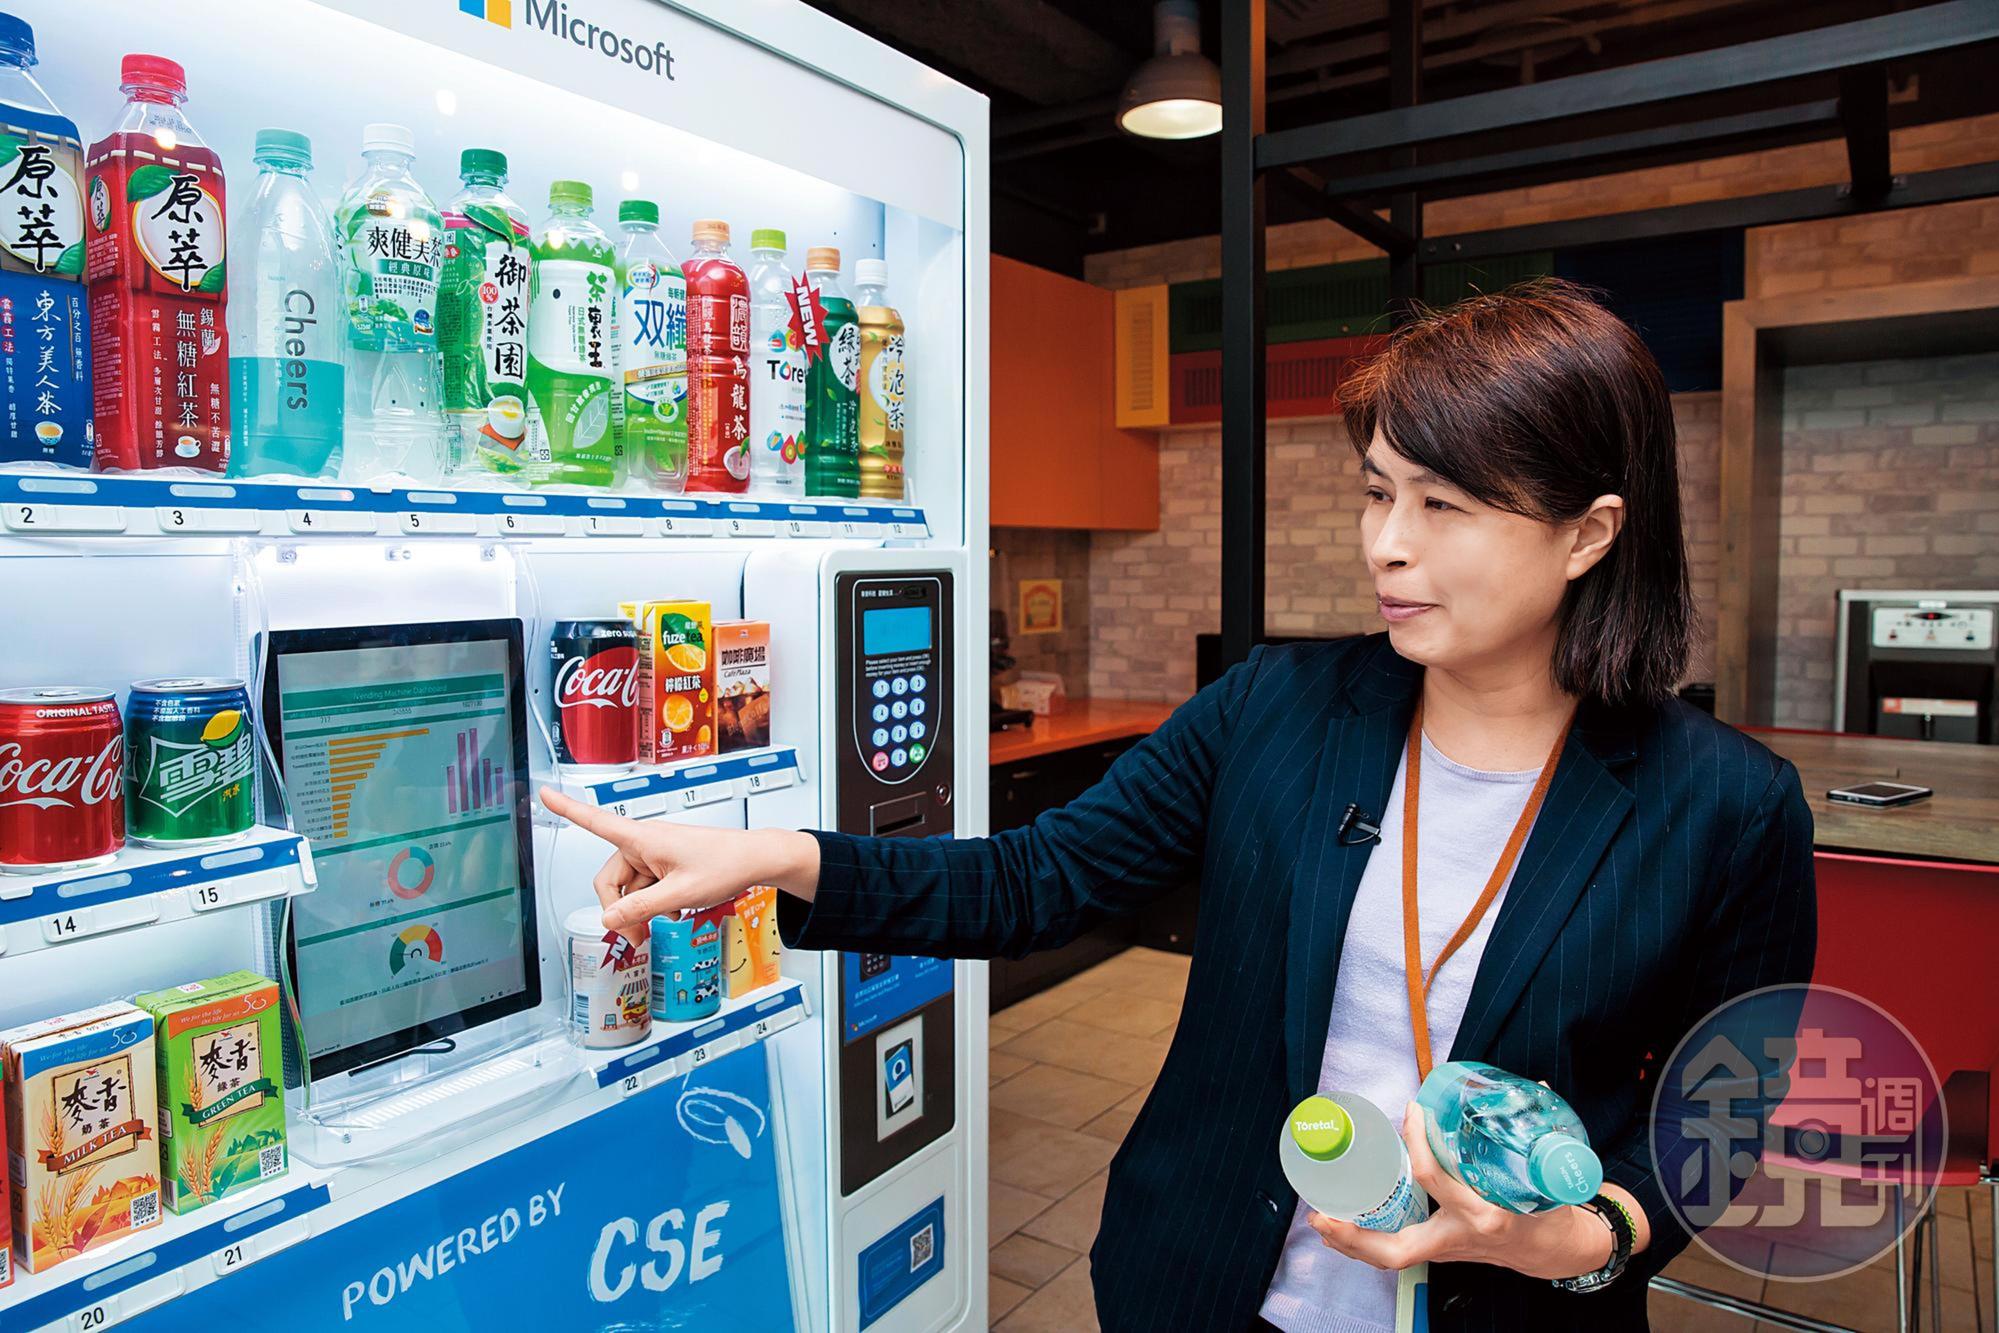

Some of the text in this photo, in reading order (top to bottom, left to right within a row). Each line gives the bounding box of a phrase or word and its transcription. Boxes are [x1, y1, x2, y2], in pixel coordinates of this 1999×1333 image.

[526, 0, 675, 81] Microsoft
[0, 146, 66, 273] 原萃
[151, 175, 210, 292] 原萃
[366, 226, 442, 270] 爽健美茶
[71, 297, 82, 343] 百分之百
[494, 254, 527, 380] 御茶園
[796, 285, 818, 347] NEW
[200, 307, 215, 353] 錫蘭
[31, 289, 62, 416] 東方美人茶
[284, 289, 317, 411] Cheers
[176, 308, 199, 429] 無糖紅茶
[889, 336, 904, 430] 冷泡茶
[732, 356, 747, 440] 烏龍茶
[21, 507, 35, 524] 2
[173, 510, 184, 526] 3
[303, 512, 312, 527] 4
[410, 513, 420, 528] 5
[507, 515, 515, 529] 6
[590, 517, 597, 530] 7
[666, 519, 673, 531] 8
[732, 520, 739, 531] 9
[790, 522, 800, 533] 10
[844, 523, 853, 533] 11
[893, 524, 902, 534] 12
[601, 629, 622, 637] zero
[662, 630, 704, 645] fuze tea
[721, 646, 766, 666] 咖啡廣場
[36, 703, 116, 718] ORIGINAL TASTE
[159, 732, 252, 803] 雪碧
[750, 776, 760, 787] 18
[685, 790, 695, 803] 17
[614, 804, 626, 816] 16
[198, 887, 219, 905] 15
[53, 916, 77, 936] 14
[757, 1023, 768, 1035] 24
[201, 1038, 257, 1087] 麥香
[695, 1049, 706, 1062] 23
[217, 1077, 241, 1093] 綠茶
[625, 1076, 639, 1091] 22
[62, 1077, 127, 1130] 麥香
[201, 1084, 256, 1119] GREEN TEA
[81, 1117, 111, 1137] 奶茶
[63, 1125, 128, 1166] MILK TEA
[1564, 1151, 1589, 1194] Cheers
[225, 1245, 243, 1267] 21
[341, 1182, 566, 1321] POWERED BY
[587, 1201, 731, 1303] CSE
[81, 1306, 105, 1331] 20
